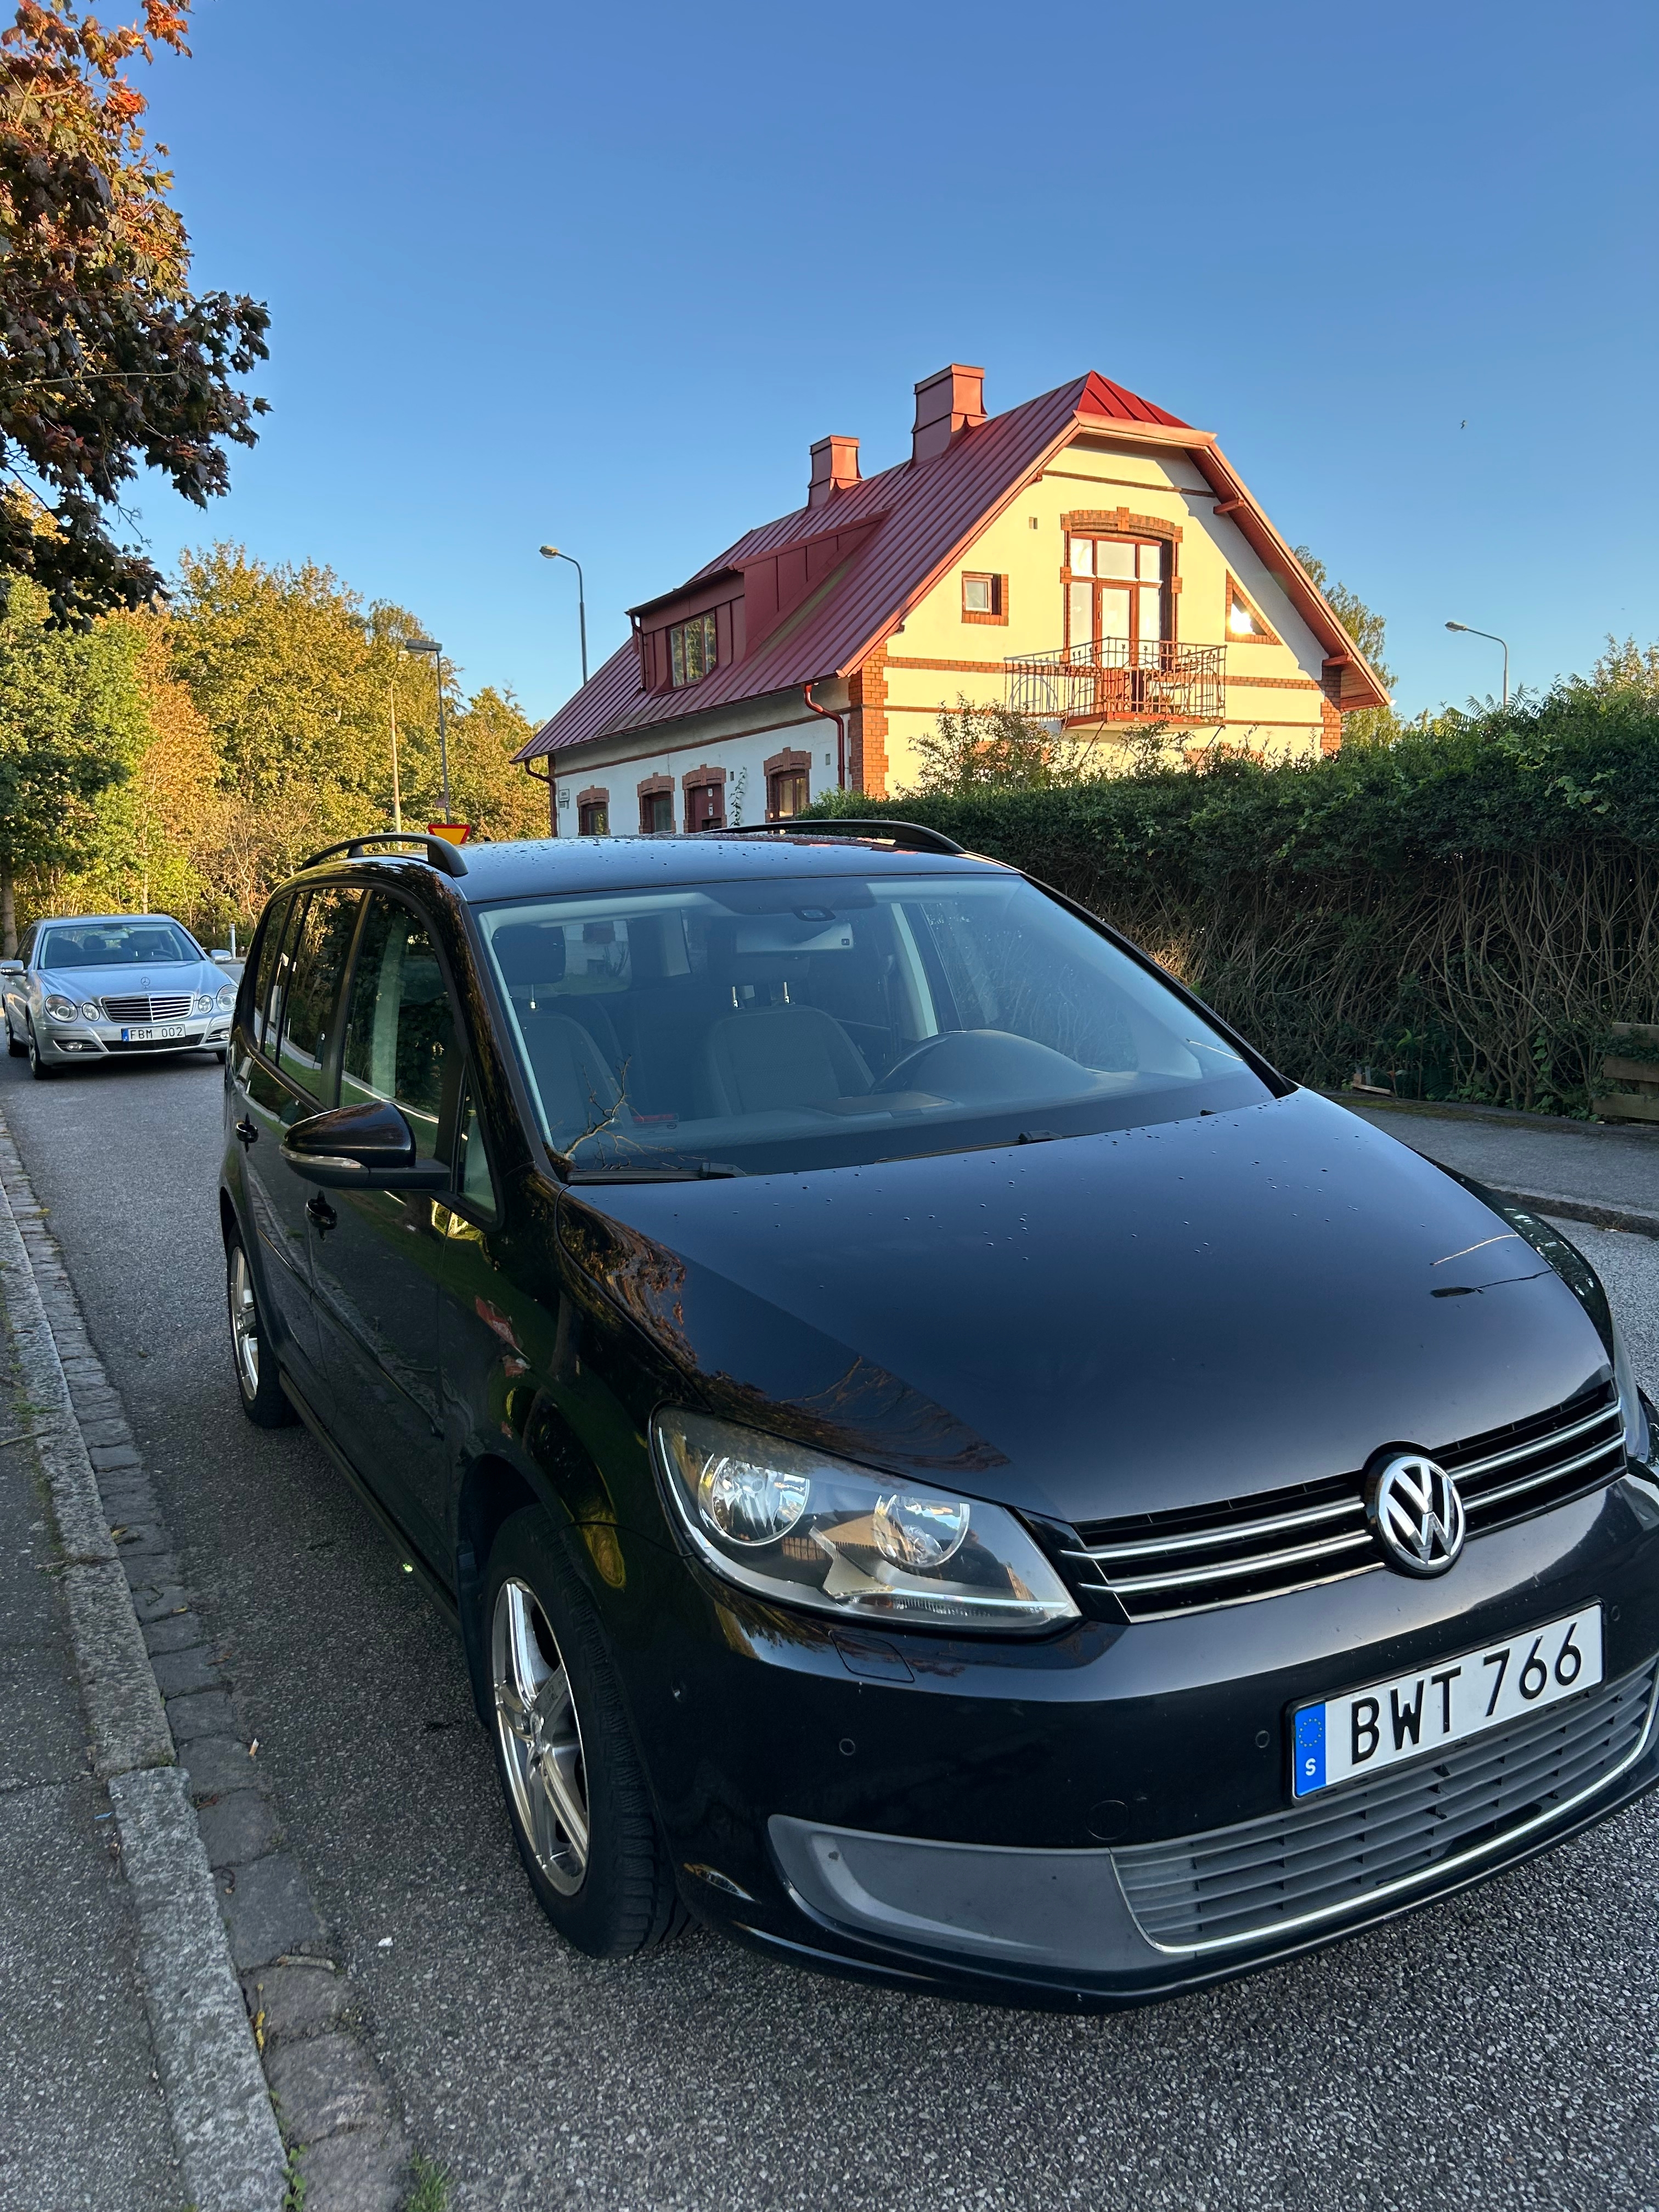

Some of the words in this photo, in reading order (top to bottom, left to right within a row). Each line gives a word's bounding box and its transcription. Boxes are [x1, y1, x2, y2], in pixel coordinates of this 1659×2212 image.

[130, 1029, 153, 1040] FBM
[162, 1027, 183, 1037] 002
[1351, 1665, 1462, 1765] BWT
[1482, 1621, 1582, 1717] 766
[1305, 1757, 1316, 1776] S
